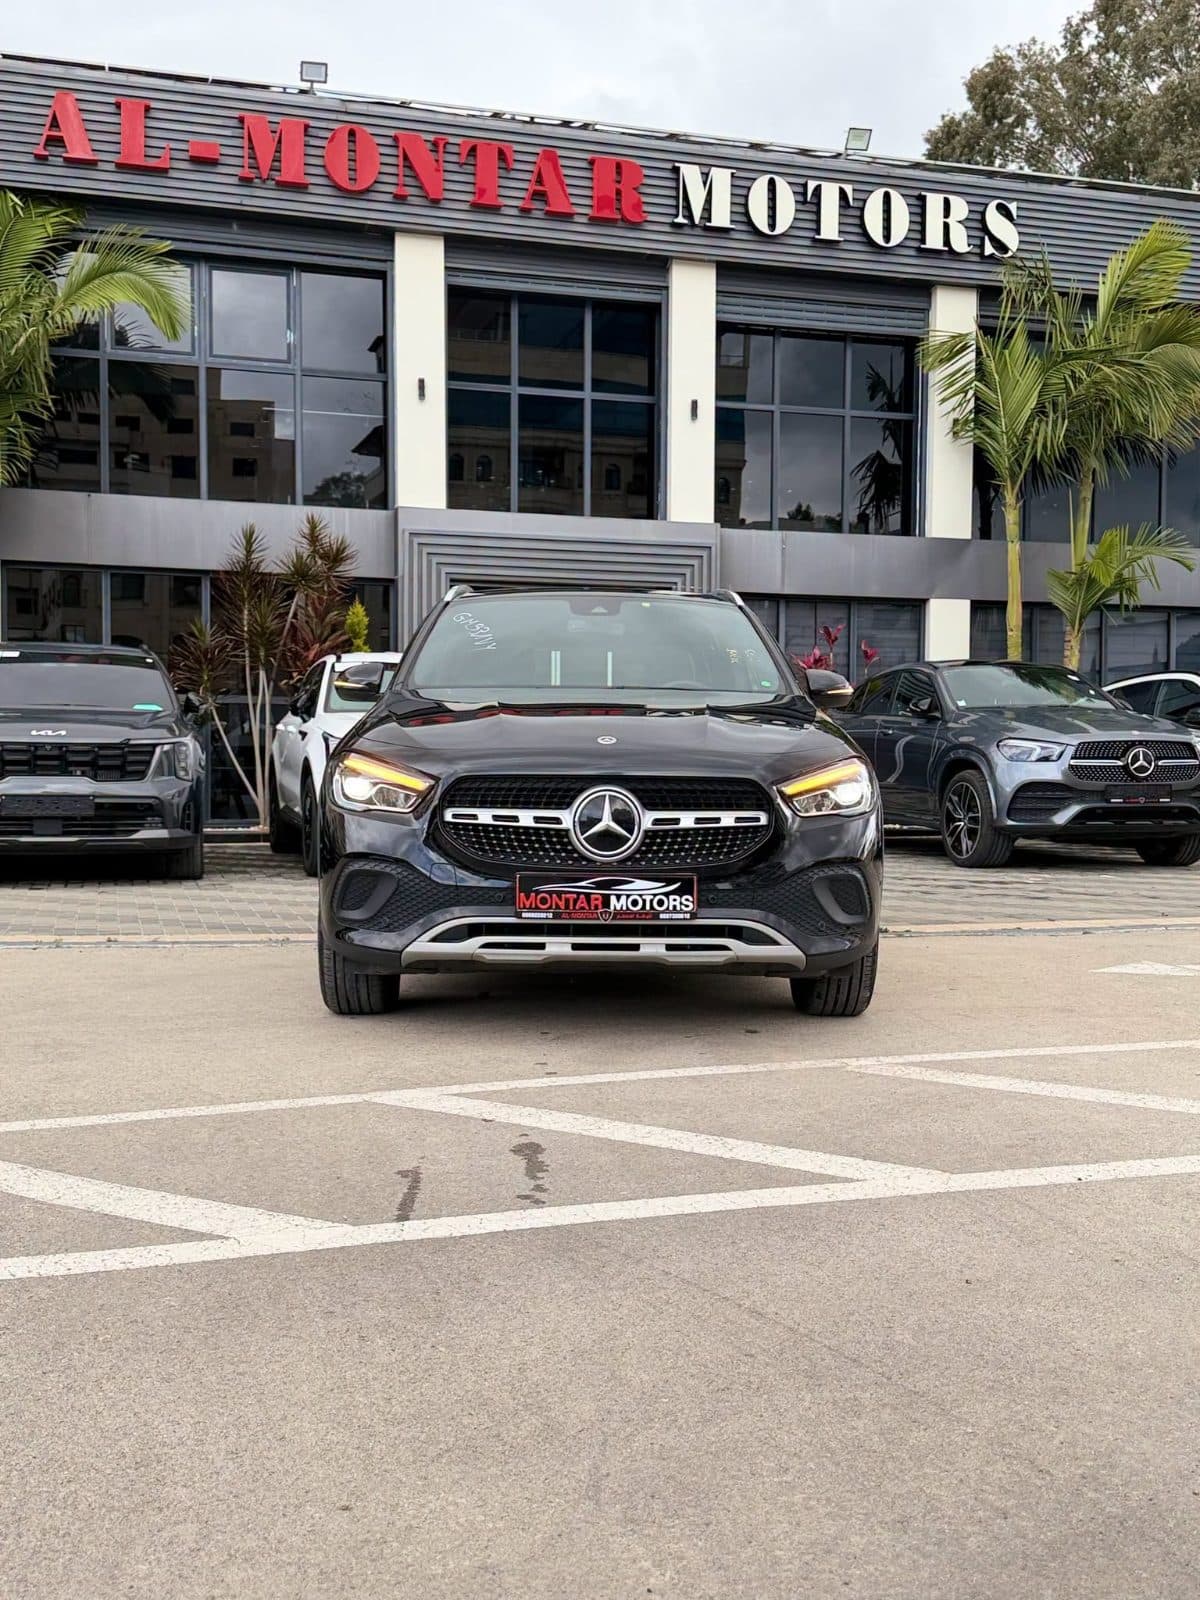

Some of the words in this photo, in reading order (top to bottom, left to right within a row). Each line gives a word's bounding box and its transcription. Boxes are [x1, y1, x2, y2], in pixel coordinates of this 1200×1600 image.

[33, 91, 648, 224] AL-MONTAR
[673, 162, 1019, 258] MOTORS
[519, 893, 602, 910] MONTAR
[610, 895, 693, 911] MOTORS
